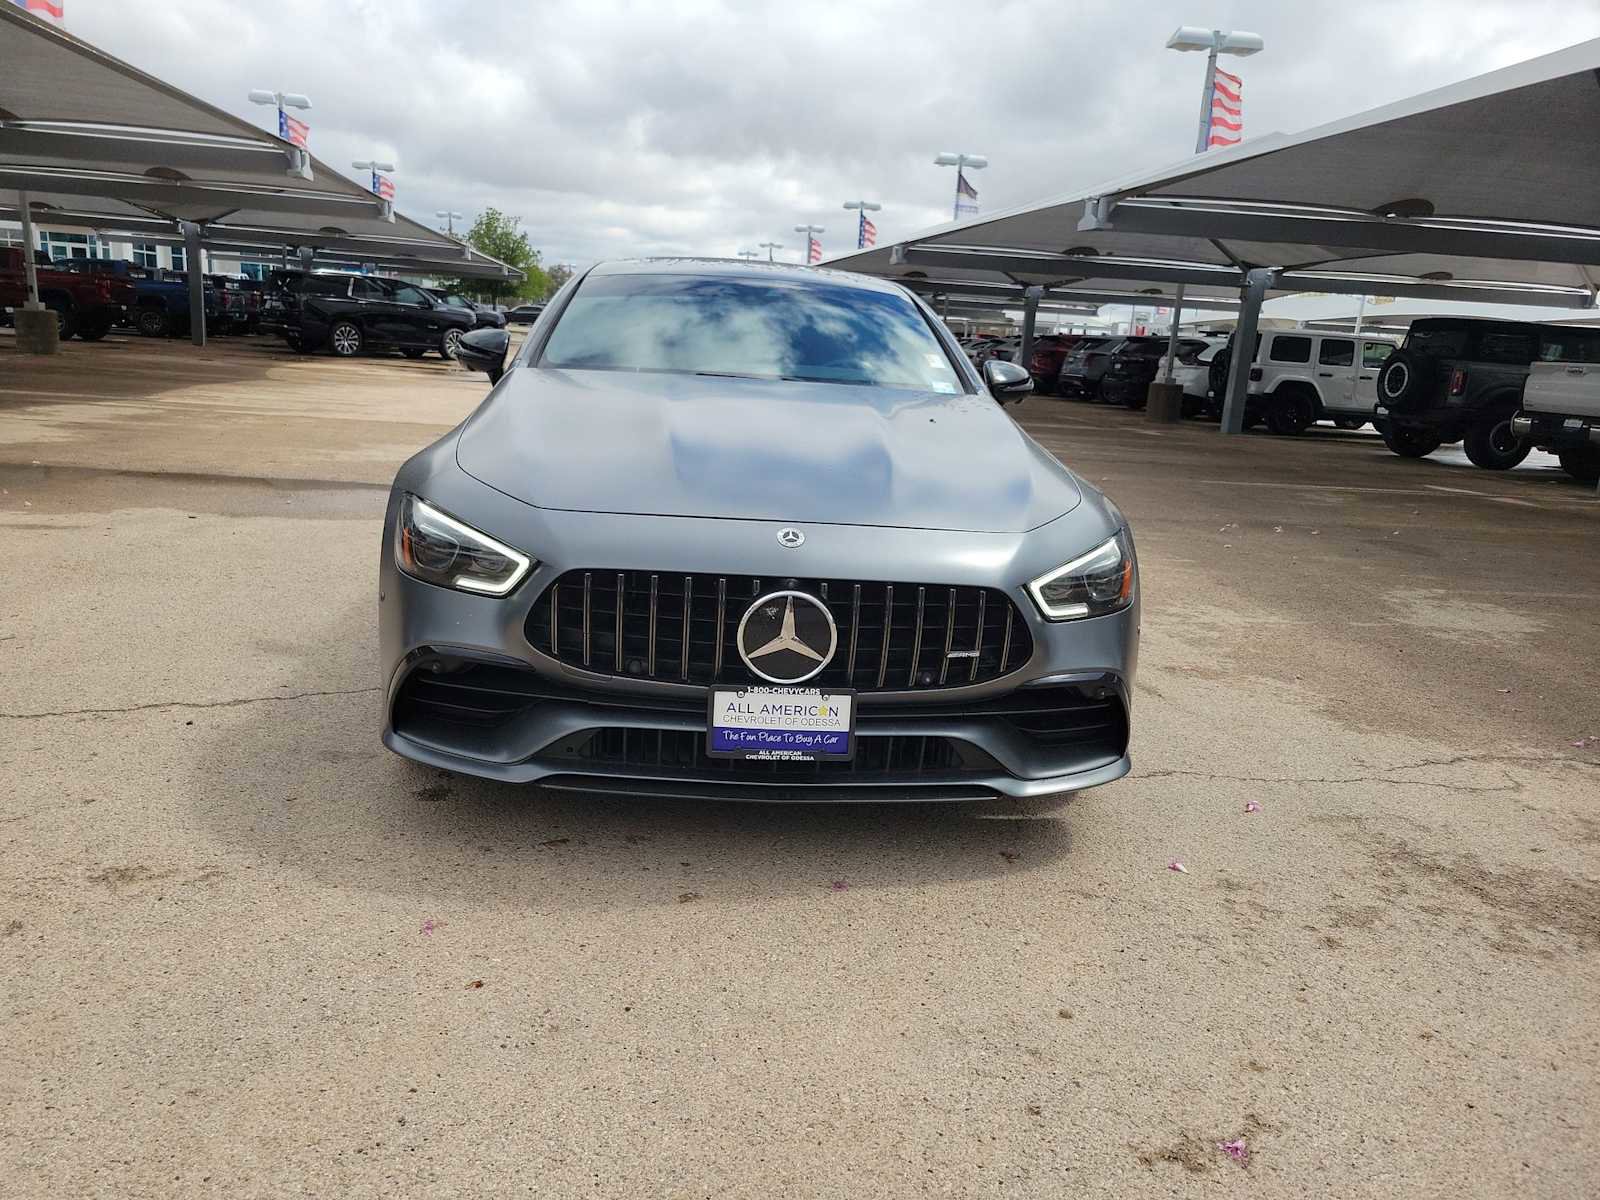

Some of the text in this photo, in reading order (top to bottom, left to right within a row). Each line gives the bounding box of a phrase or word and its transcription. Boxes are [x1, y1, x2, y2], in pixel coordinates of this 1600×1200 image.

[747, 686, 821, 696] 1-800-CHEVYCARS
[726, 702, 839, 717] ALL AMERICN
[722, 714, 841, 727] CHEVROLET OF ODESSA
[722, 730, 739, 741] The
[758, 731, 782, 743] Place
[783, 731, 794, 743] To
[795, 734, 813, 746] Buy
[813, 735, 822, 744] A
[823, 734, 840, 744] Car
